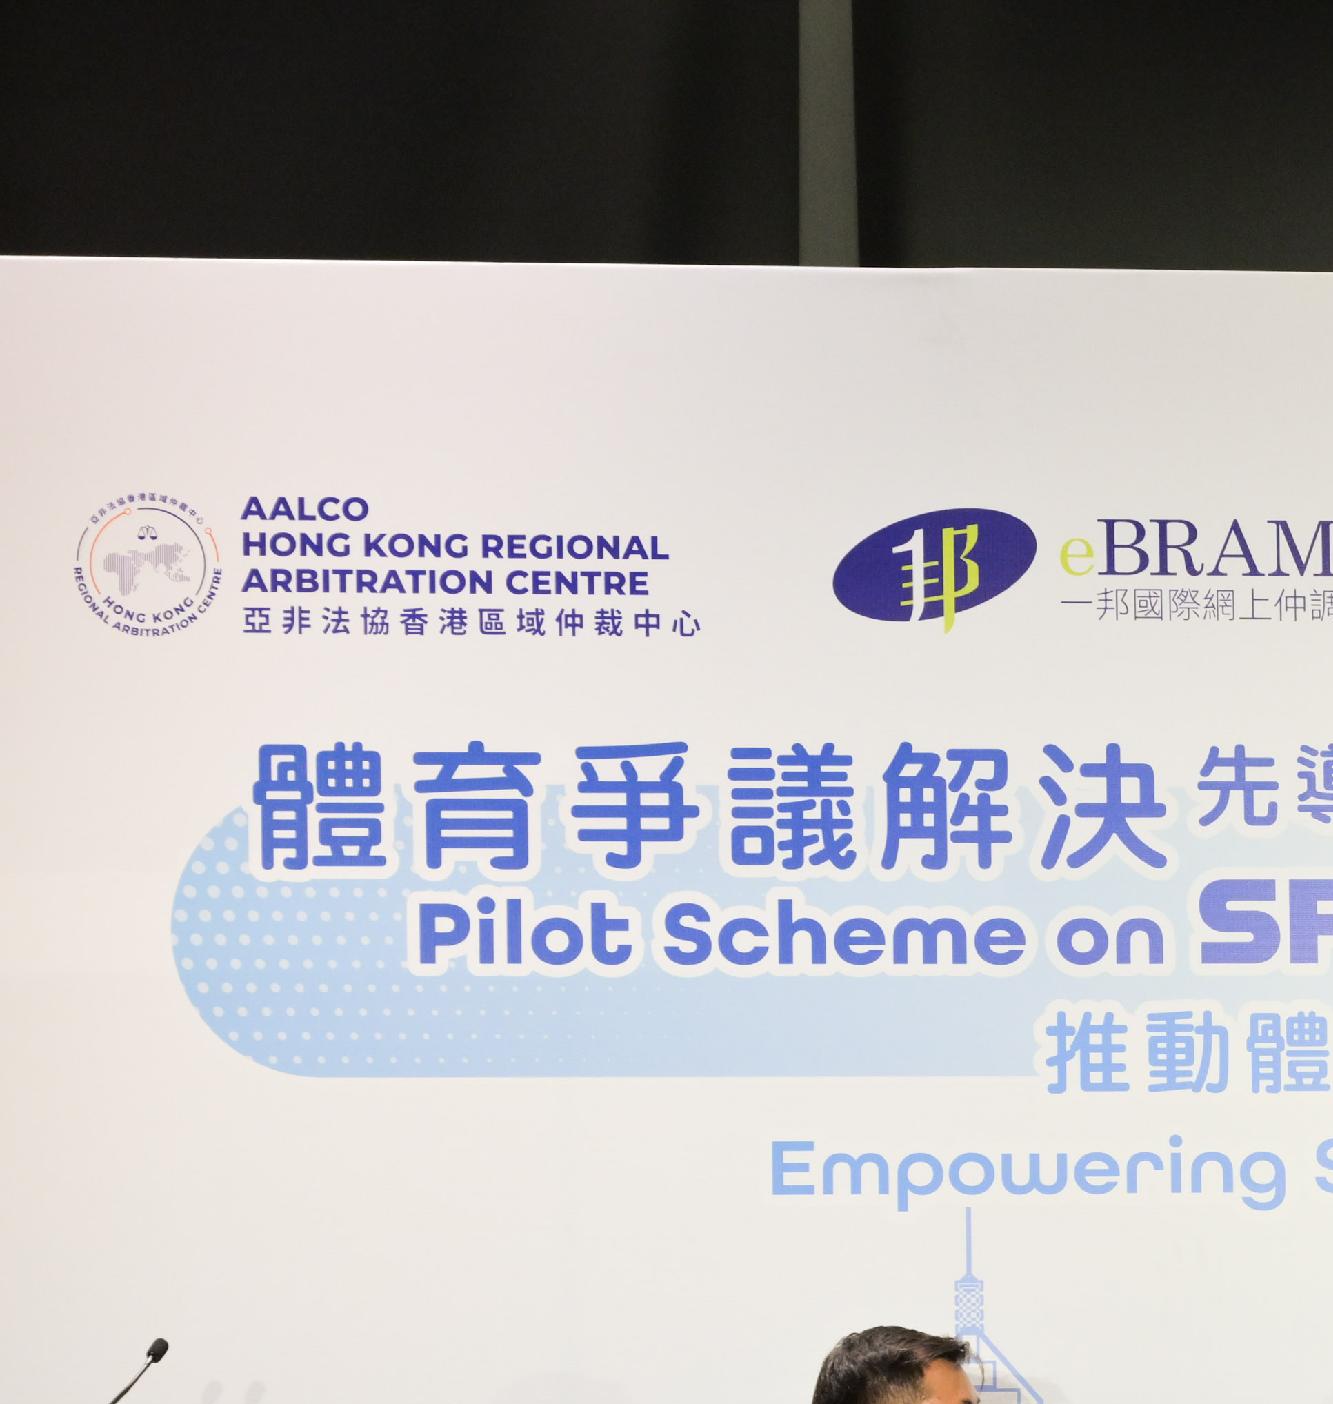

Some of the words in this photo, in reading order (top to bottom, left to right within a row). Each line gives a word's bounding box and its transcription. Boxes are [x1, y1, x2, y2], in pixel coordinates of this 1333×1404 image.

[241, 497, 370, 521] AALCO
[242, 532, 350, 557] HONG
[364, 532, 468, 558] KONG
[482, 534, 670, 560] REGIONAL
[241, 568, 492, 594] ARBITRATION
[506, 569, 650, 596] CENTRE
[73, 567, 109, 624] REGIONAL
[111, 612, 198, 637] ARBITRATION
[196, 567, 223, 614] CENTRE
[102, 595, 146, 623] HONG
[152, 595, 194, 623] KONG
[241, 606, 701, 637] 亞非法協香港區域仲裁中心
[418, 898, 634, 966] Pilot
[663, 898, 1027, 966] Scheme
[1056, 914, 1165, 966] on
[769, 1134, 1287, 1212] Empowering
